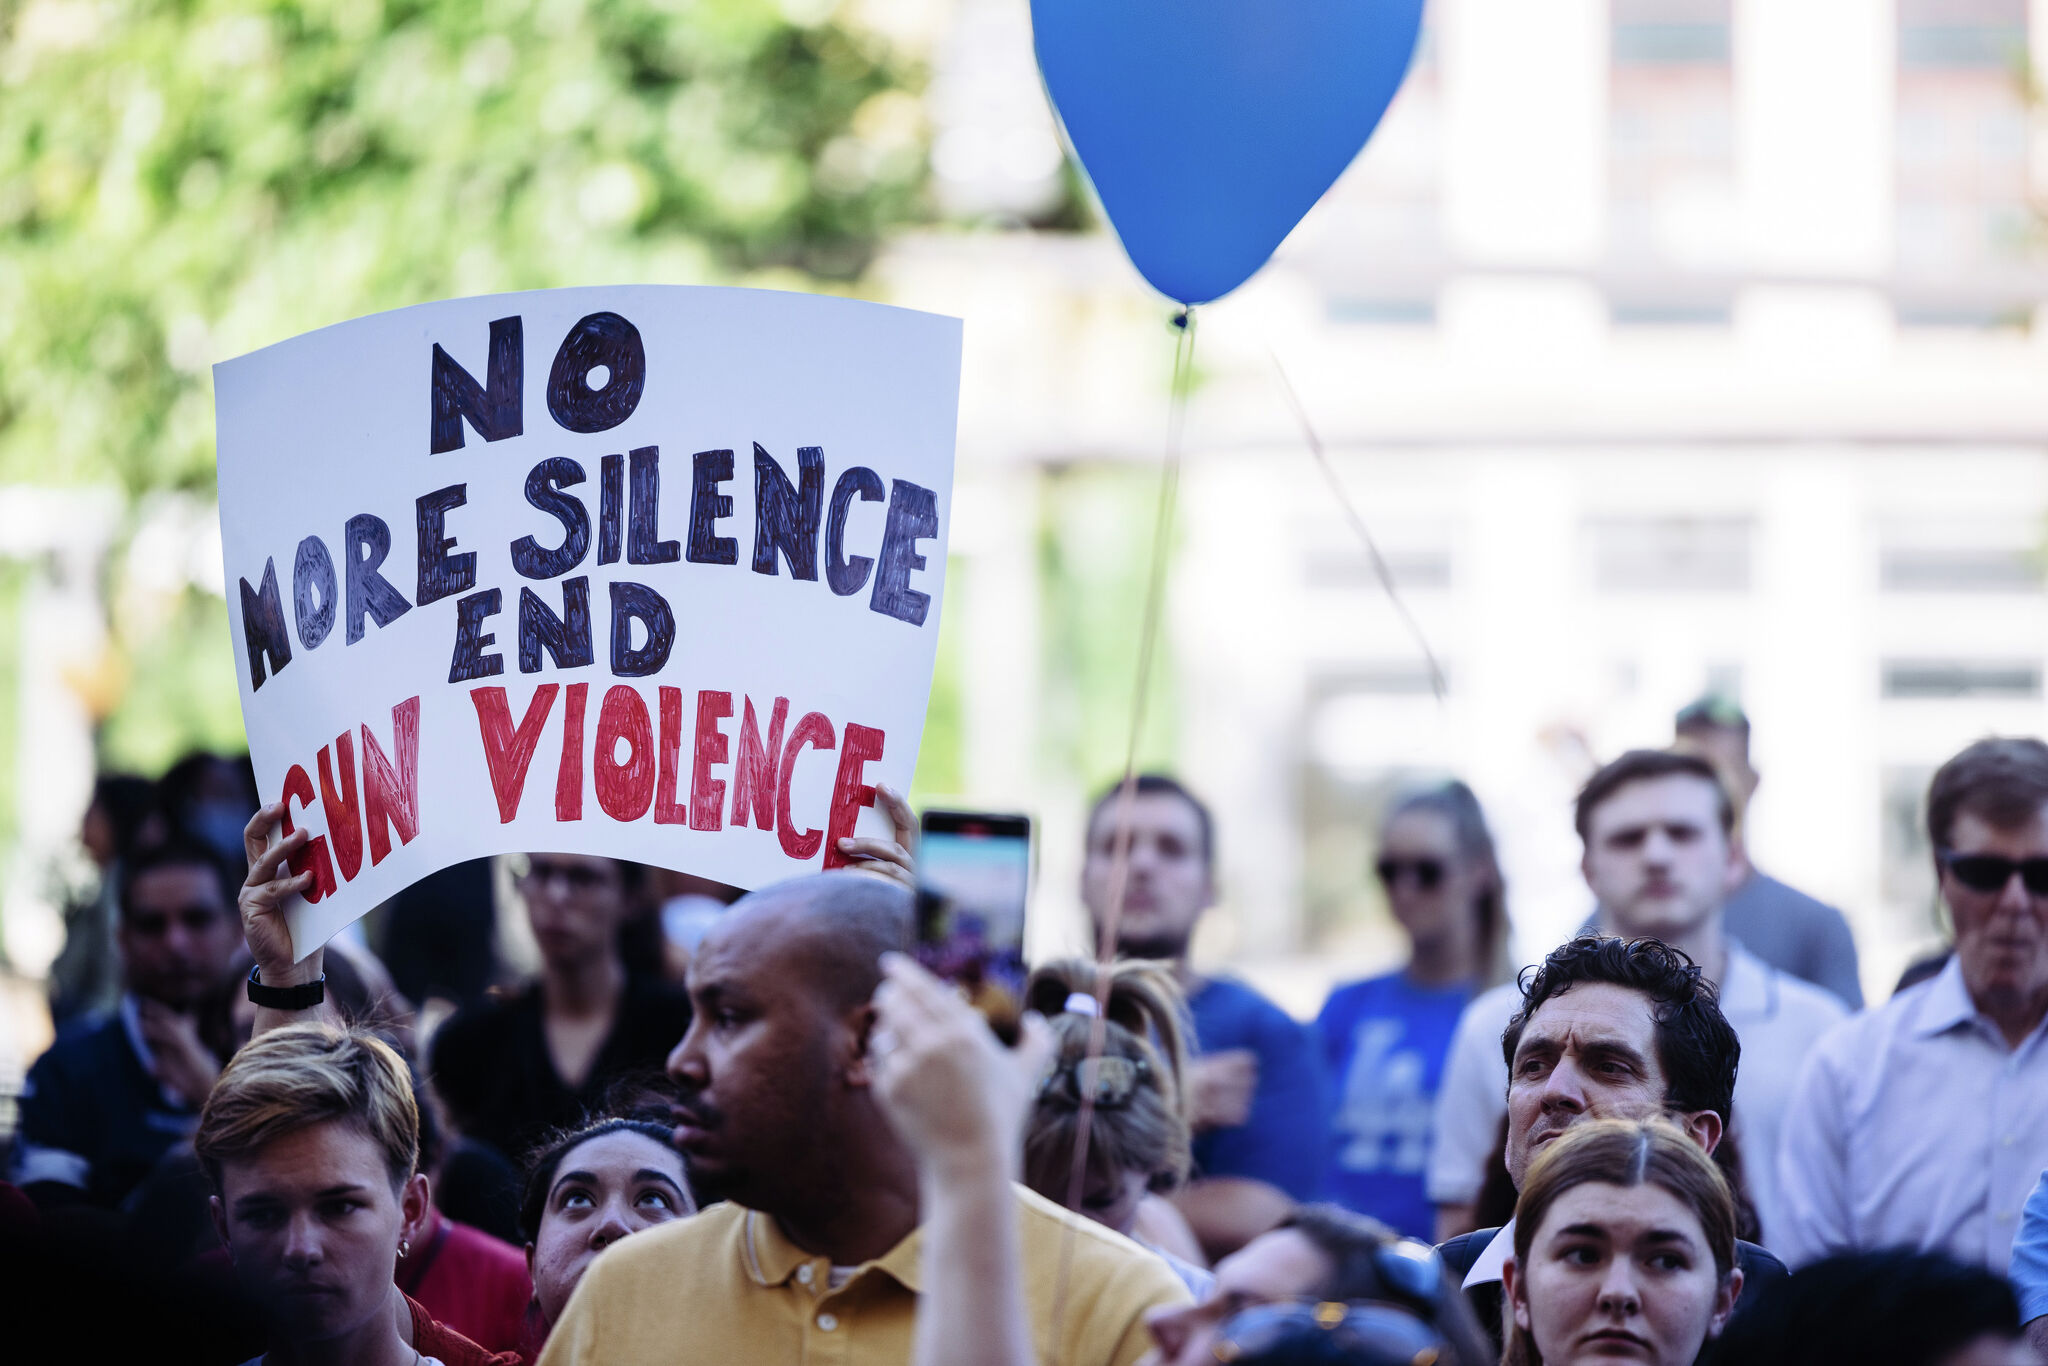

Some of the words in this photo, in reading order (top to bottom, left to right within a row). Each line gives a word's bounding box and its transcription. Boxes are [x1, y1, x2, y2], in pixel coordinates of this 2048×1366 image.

[430, 311, 646, 455] NO
[239, 483, 477, 692] MORE
[510, 441, 940, 627] SILENCE
[448, 576, 676, 683] END
[281, 695, 420, 904] GUN
[470, 682, 886, 871] VIOLENCE
